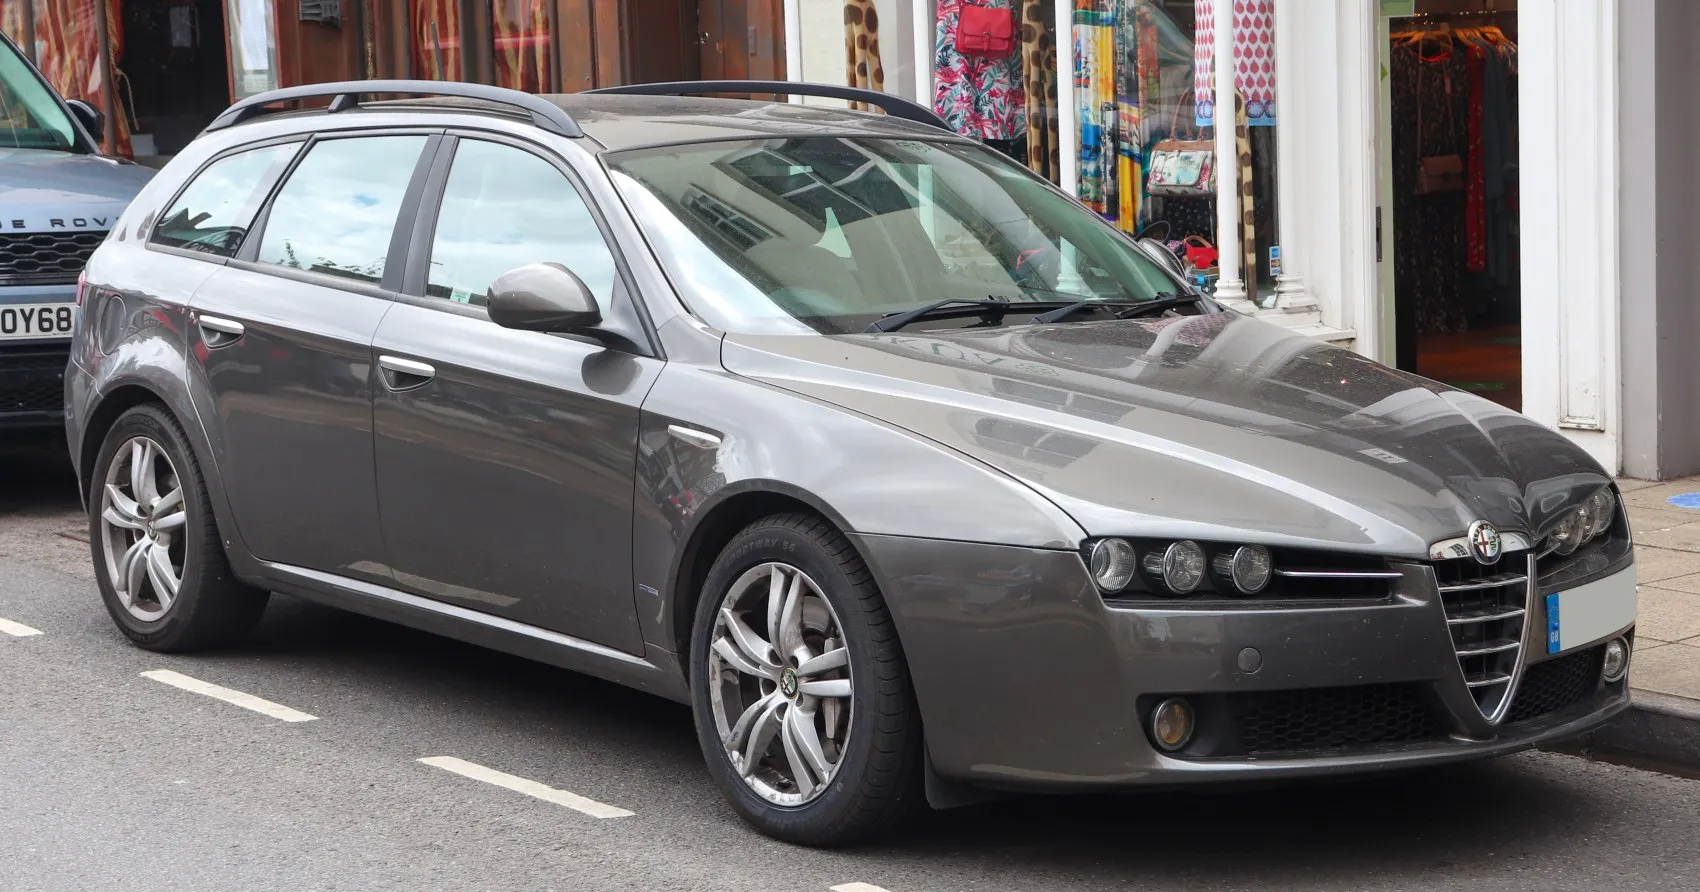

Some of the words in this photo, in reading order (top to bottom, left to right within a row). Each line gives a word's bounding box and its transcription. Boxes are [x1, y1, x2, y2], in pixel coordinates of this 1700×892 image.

[0, 219, 26, 229] E
[49, 217, 119, 228] ROV
[1, 307, 72, 334] OY68
[1550, 630, 1559, 643] GB
